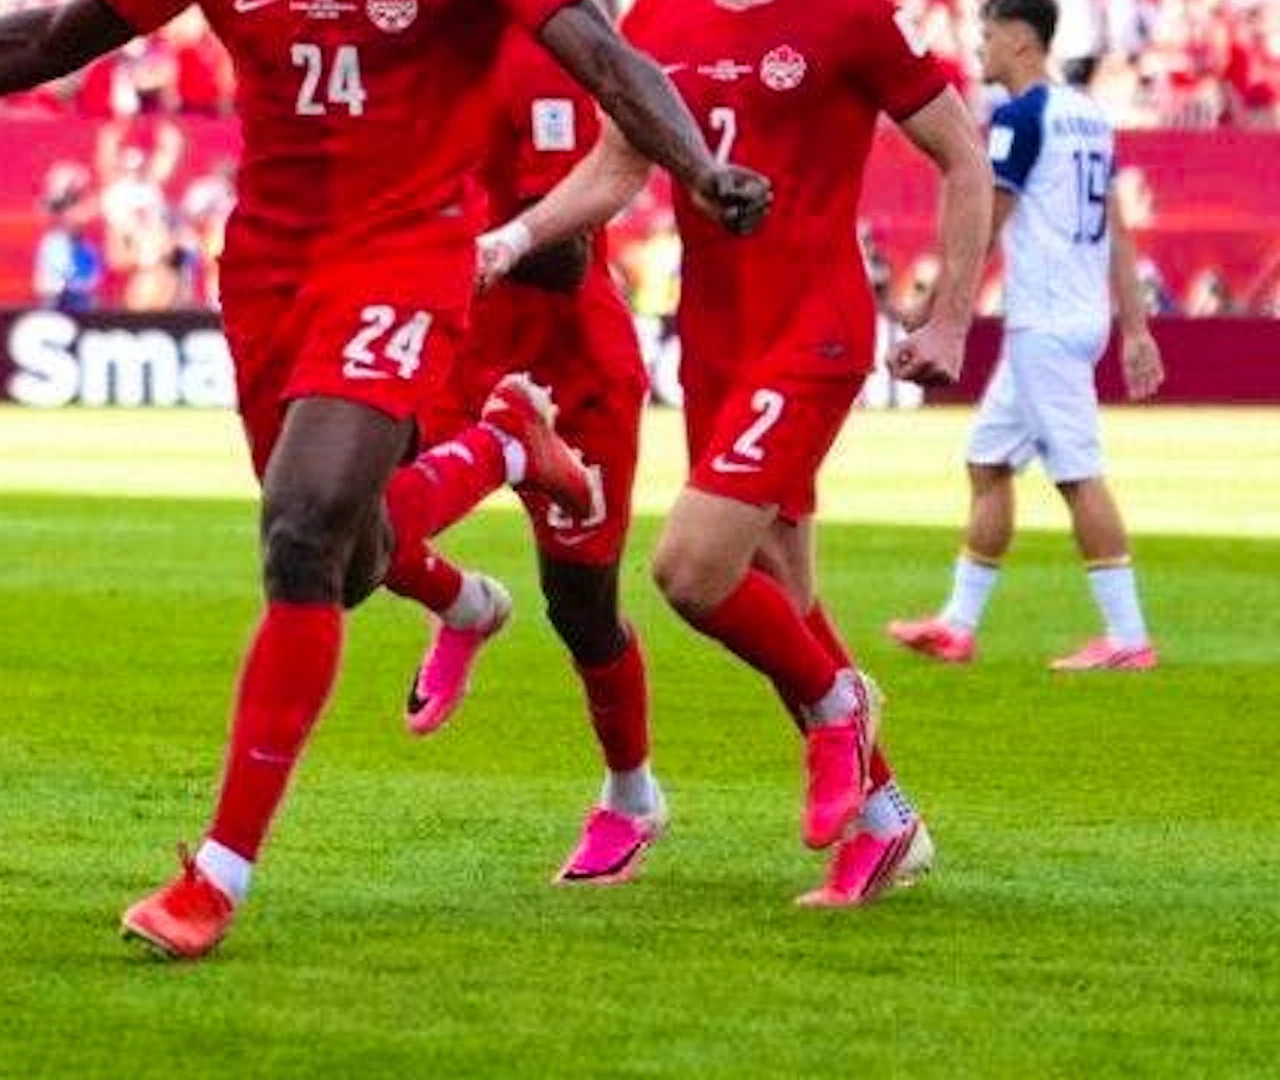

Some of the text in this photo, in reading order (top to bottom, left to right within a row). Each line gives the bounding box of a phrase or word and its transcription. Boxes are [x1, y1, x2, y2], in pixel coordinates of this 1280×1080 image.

[290, 43, 368, 117] 24
[342, 304, 434, 380] 24
[732, 387, 785, 461] 2
